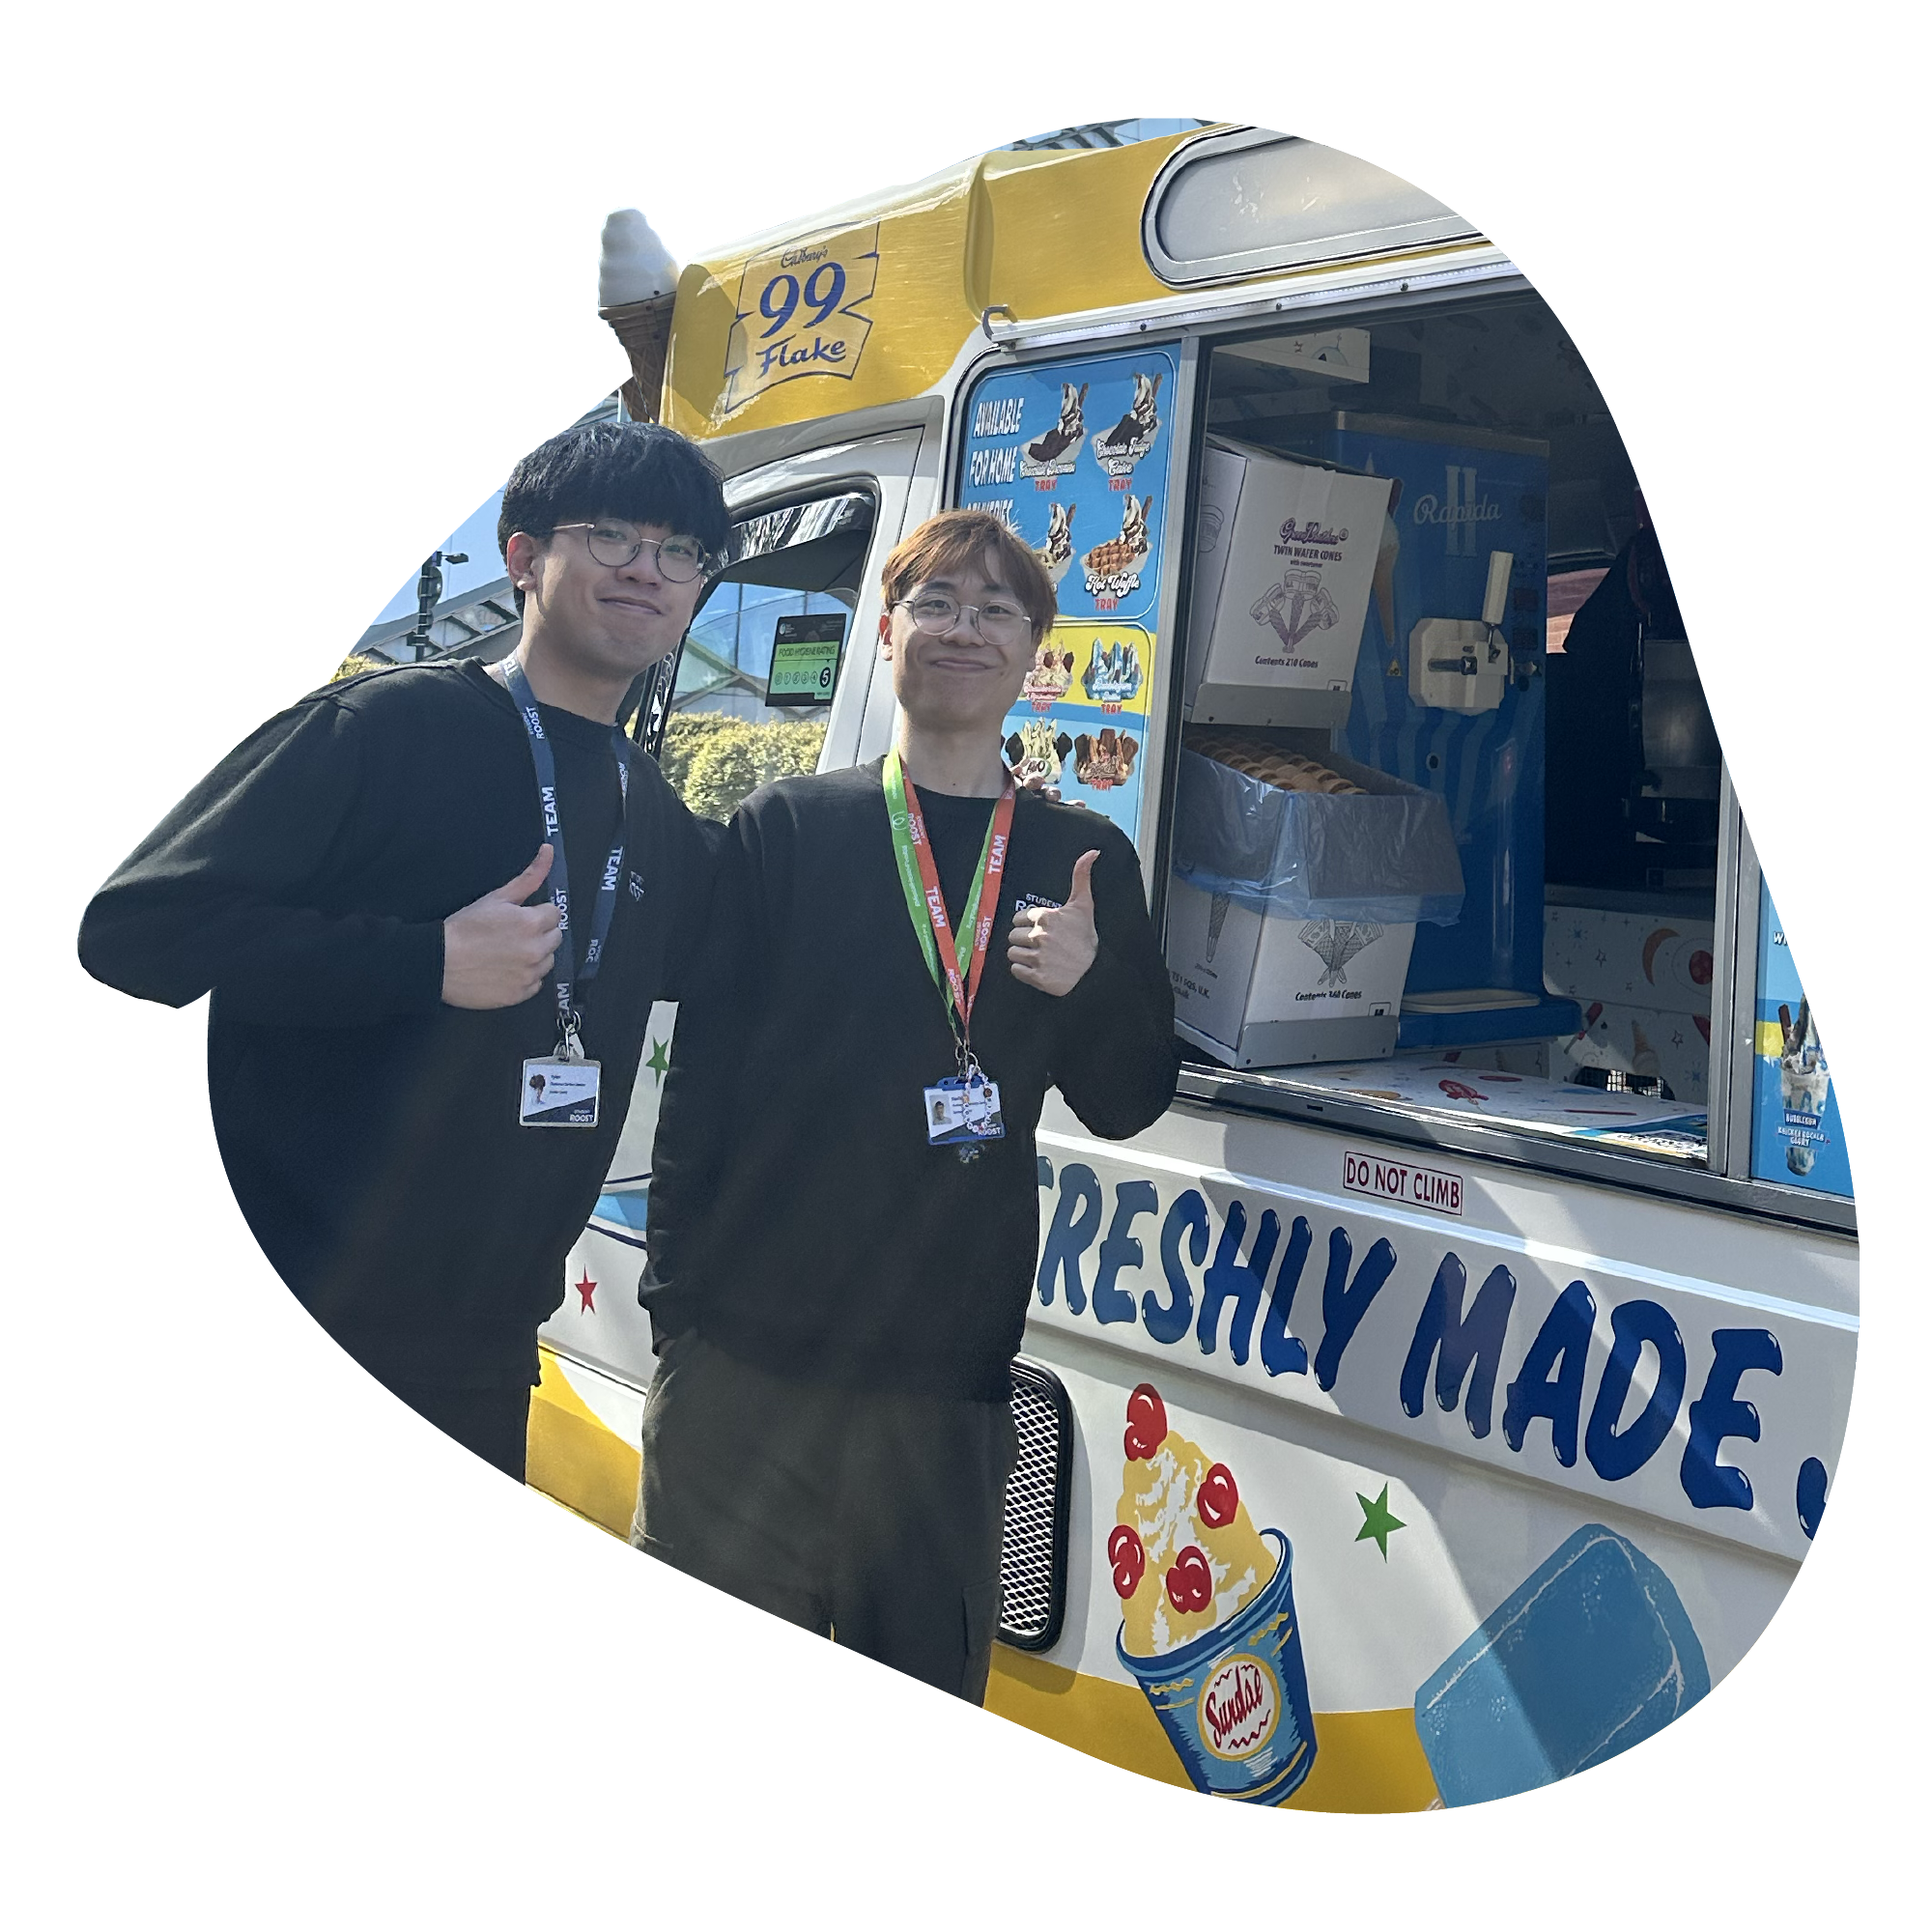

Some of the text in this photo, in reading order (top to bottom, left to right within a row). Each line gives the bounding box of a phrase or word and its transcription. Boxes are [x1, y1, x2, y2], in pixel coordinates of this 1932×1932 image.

[759, 262, 846, 339] 99
[755, 333, 847, 380] Flake
[973, 397, 1025, 439] AVAILABLE
[968, 445, 1019, 488] FOR HOME
[1414, 494, 1503, 531] Rapida
[1273, 544, 1343, 562] TWIN WAFER CONES
[1085, 571, 1141, 598] Hot Waffle
[1094, 598, 1120, 612] TRAY
[821, 669, 830, 686] 5
[1286, 658, 1299, 668] 210
[526, 706, 546, 739] ROOST
[1101, 703, 1122, 715] TRAY
[542, 786, 559, 837] TEAM
[908, 812, 923, 845] ROOST
[601, 845, 623, 891] TEAM
[988, 835, 1007, 875] TEAM
[555, 888, 569, 930] ROOST
[924, 886, 948, 928] TEAM
[1026, 893, 1064, 910] STUDENT
[979, 916, 993, 952] ROOST
[569, 1114, 594, 1122] ROOST
[1346, 1156, 1460, 1208] DO NOT CLIMB
[1037, 1155, 1398, 1392] RESHLY
